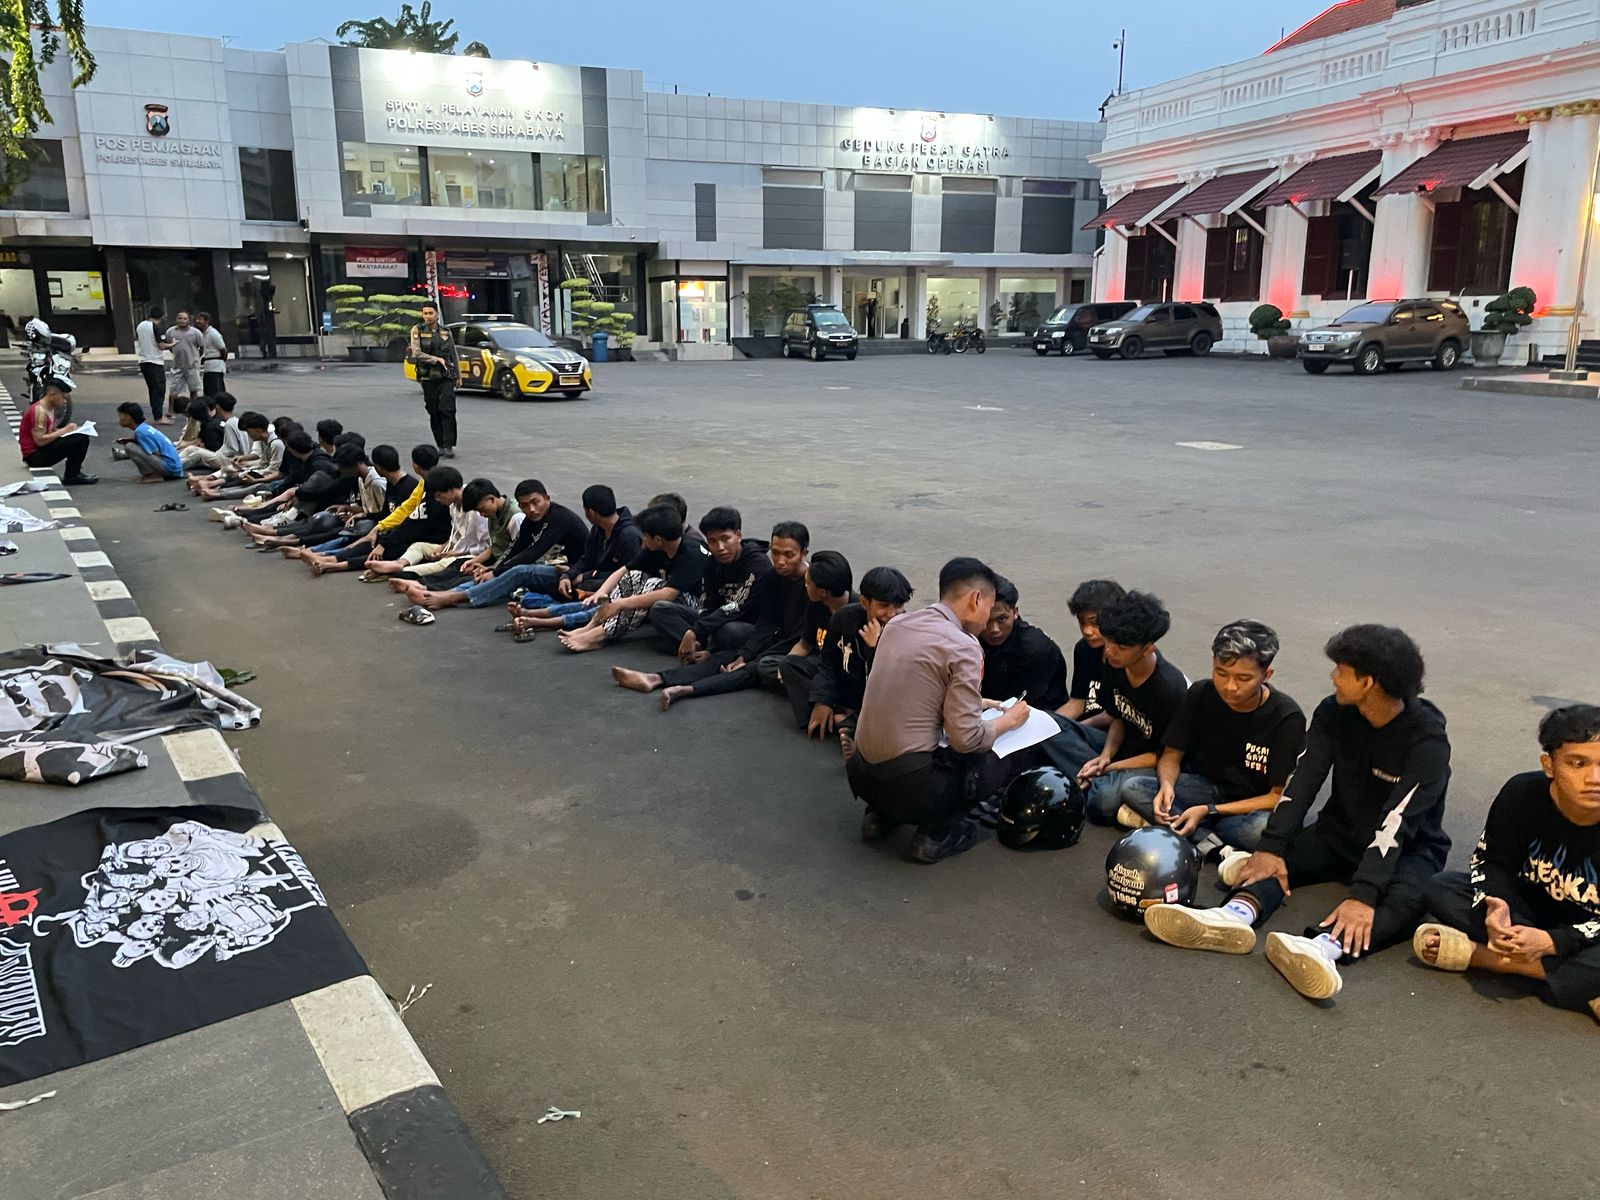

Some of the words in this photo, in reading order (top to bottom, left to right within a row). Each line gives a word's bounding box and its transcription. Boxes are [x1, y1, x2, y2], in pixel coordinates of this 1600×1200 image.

[386, 100, 419, 112] SPKT
[425, 101, 433, 113] &
[441, 103, 515, 119] PELAYANAN
[524, 109, 565, 122] SKCK
[387, 117, 487, 135] POLRESTABES
[490, 124, 565, 140] SURABAYA
[95, 137, 127, 150] POS
[131, 139, 222, 157] PENJAGAAN
[840, 139, 905, 153] GEDUNG
[911, 143, 954, 157] PESAT
[961, 147, 1009, 160] GATRA
[97, 155, 168, 167] POLRESTABES
[170, 159, 222, 169] SURABAYA
[862, 155, 919, 169] BAGIAN
[927, 158, 990, 172] OPERASI
